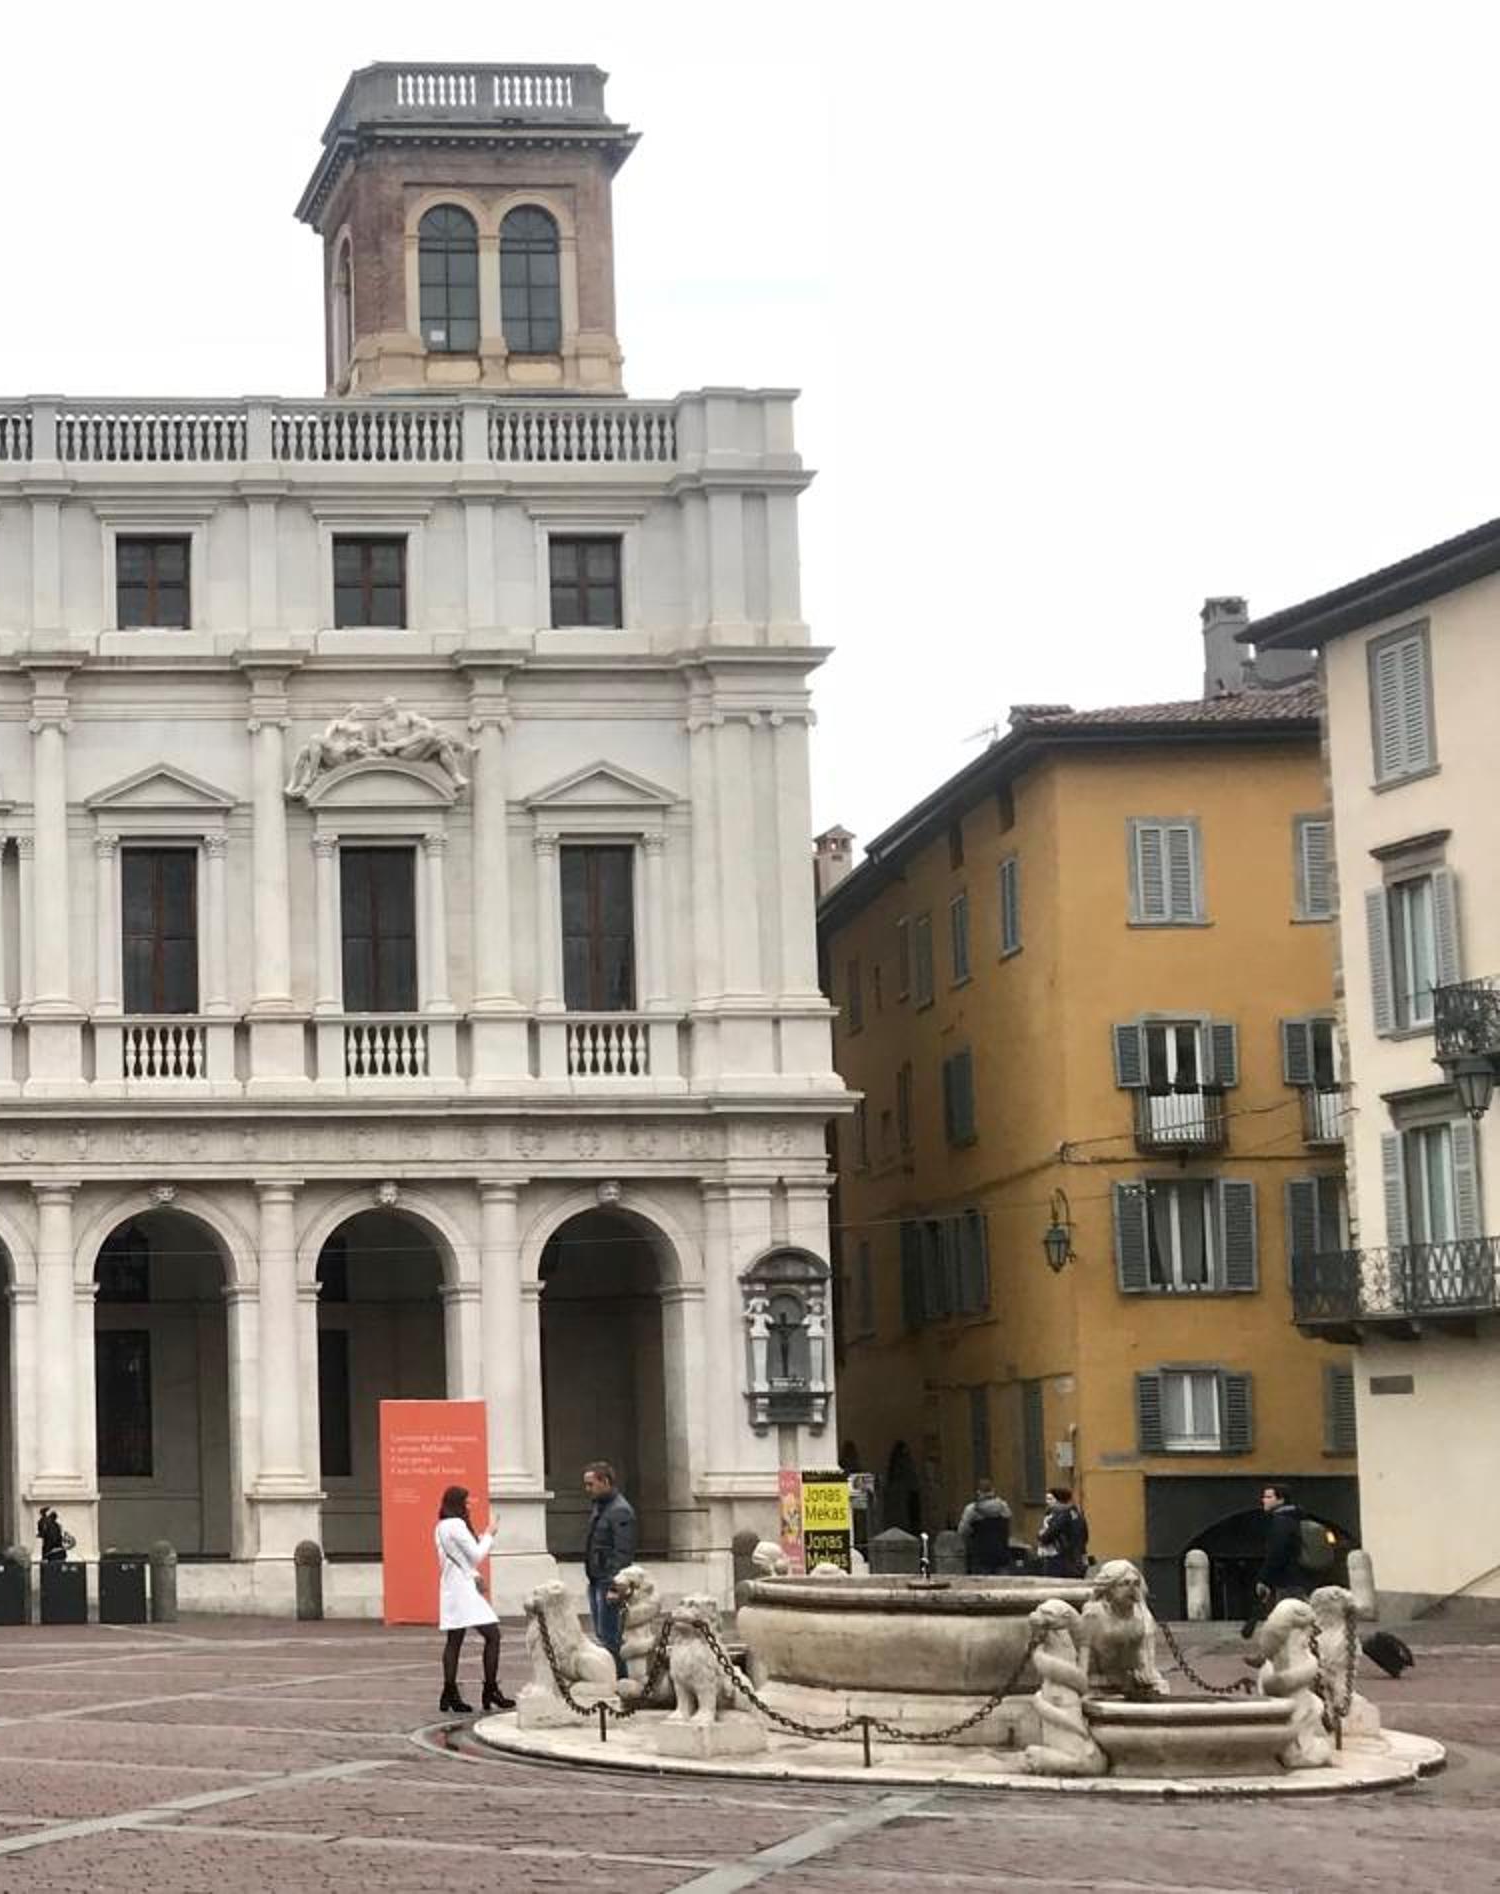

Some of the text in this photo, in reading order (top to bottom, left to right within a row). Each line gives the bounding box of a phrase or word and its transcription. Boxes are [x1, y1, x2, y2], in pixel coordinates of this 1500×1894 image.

[804, 1486, 842, 1502] Jonas
[805, 1504, 847, 1521] Mekas
[806, 1533, 843, 1549] Jonas
[807, 1551, 849, 1567] Mekas
